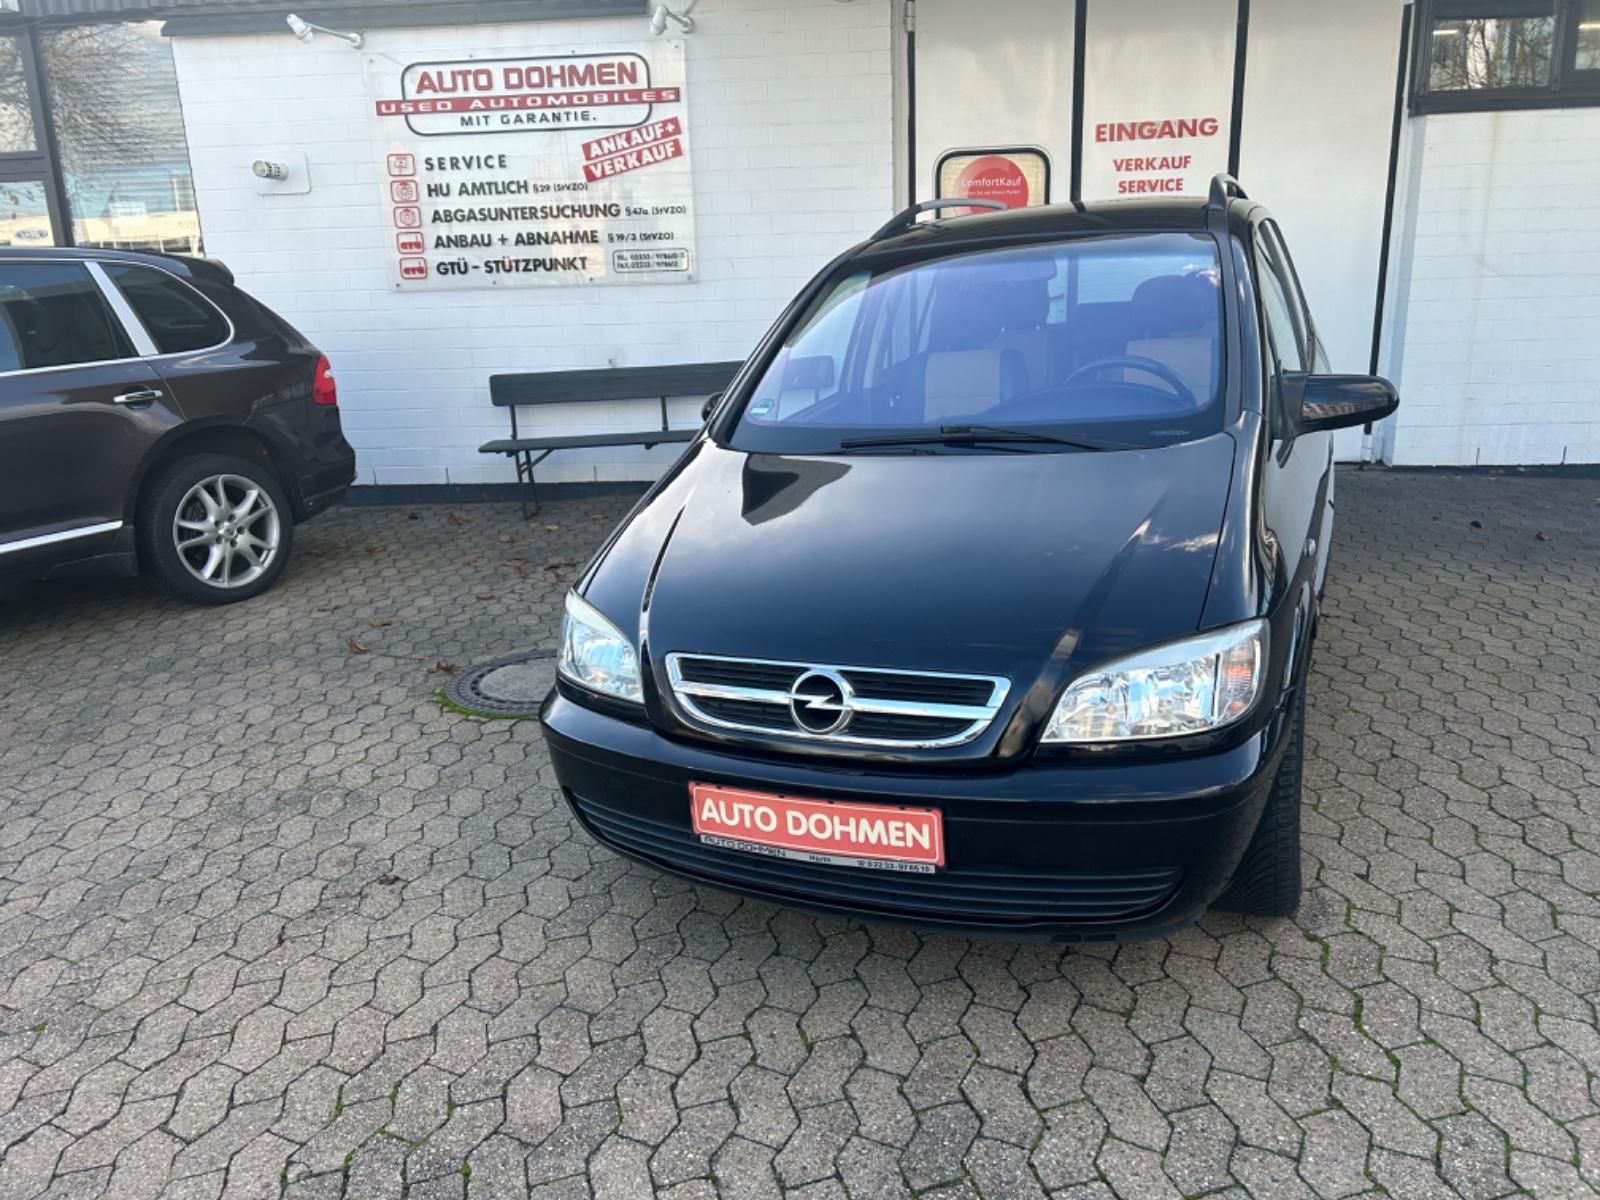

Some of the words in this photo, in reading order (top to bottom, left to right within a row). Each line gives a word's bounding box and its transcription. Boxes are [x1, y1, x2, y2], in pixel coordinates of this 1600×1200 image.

[416, 68, 493, 94] AUTO
[503, 61, 638, 90] DOHMEN
[379, 101, 453, 114] USED
[469, 90, 676, 110] AUTOMOBILES
[460, 115, 490, 127] MIT
[501, 110, 597, 125] GARANTIE.
[1095, 117, 1218, 142] EINGANG
[424, 154, 507, 171] SERVICE
[589, 141, 675, 178] VERKAUF
[1113, 155, 1191, 172] VERKAUF
[427, 183, 450, 198] HU
[458, 180, 528, 196] AMTLICH
[1118, 178, 1184, 194] SERVICE
[431, 203, 621, 223] ABGASUNTERSUCHUNG
[434, 233, 492, 249] ANBAU
[514, 230, 600, 247] ABNAHME
[436, 257, 469, 275] GTÜ
[484, 255, 588, 273] STÜTZPUNKT
[701, 798, 777, 832] AUTO
[786, 810, 930, 849] DOHMEN
